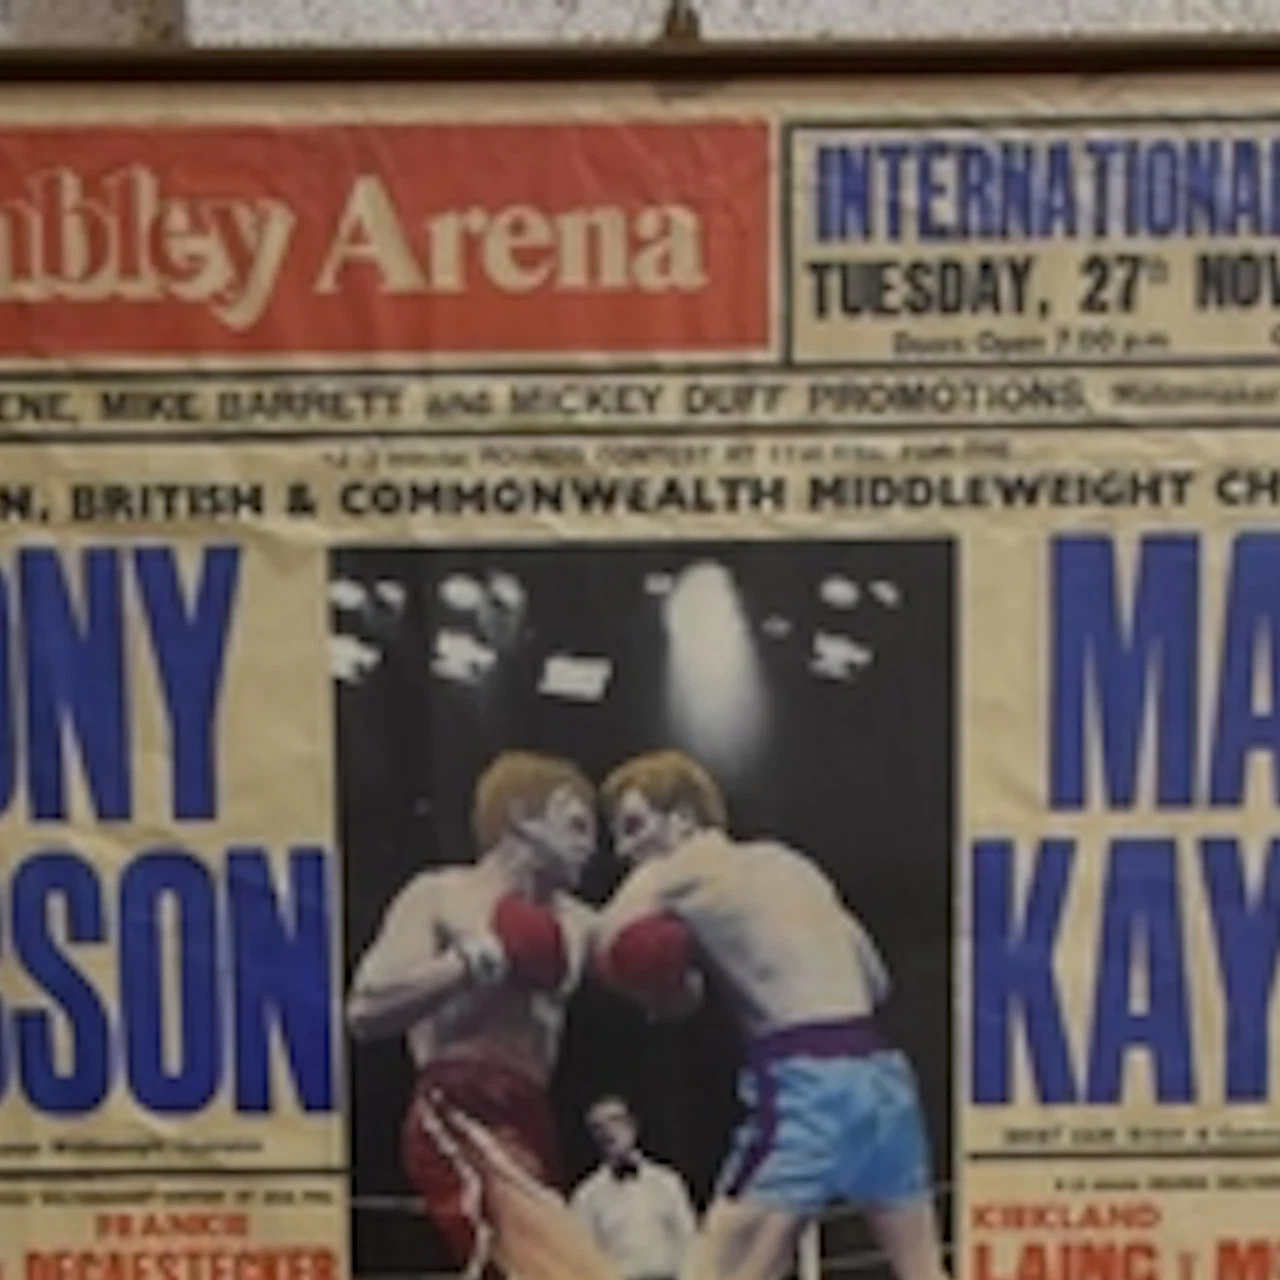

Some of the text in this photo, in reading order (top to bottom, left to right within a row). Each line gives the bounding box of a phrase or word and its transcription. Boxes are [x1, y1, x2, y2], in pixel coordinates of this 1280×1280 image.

[315, 174, 708, 293] Arena
[805, 254, 1050, 320] TUESDAY,
[99, 389, 202, 421] MIKE
[216, 386, 404, 421] BARRETT
[510, 384, 664, 416] MICKEY
[685, 383, 785, 414] DUFF
[72, 483, 263, 521] BRITISH
[288, 484, 316, 519] &
[340, 478, 786, 517] COMMONWEALTH
[807, 470, 1196, 513] MIDDLEWEIGHT
[969, 1201, 1162, 1231] KIRKLAND
